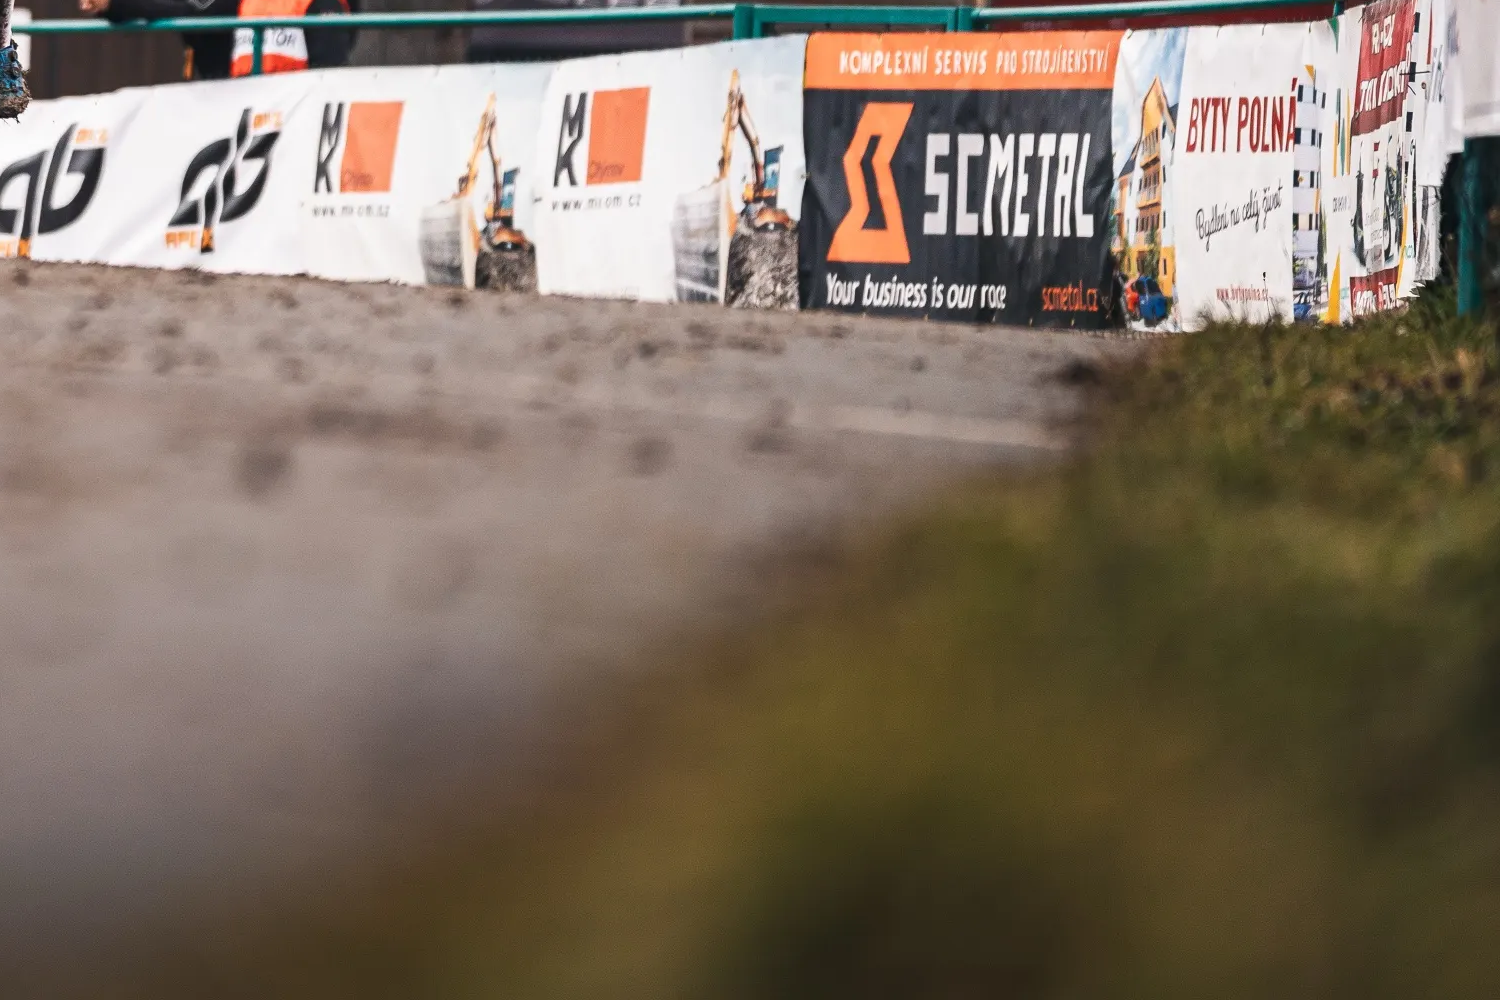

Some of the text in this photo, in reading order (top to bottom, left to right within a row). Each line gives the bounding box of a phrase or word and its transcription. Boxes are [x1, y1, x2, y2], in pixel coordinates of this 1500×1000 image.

[839, 41, 1110, 75] KOMPLEXNÍ SERVIS PRO STROJÍRENSTVÍ
[1186, 96, 1232, 153] BYTY
[1236, 77, 1298, 153] POLNÁ
[923, 133, 1094, 238] SCMETAL
[1196, 203, 1229, 252] Bydlení
[1231, 207, 1241, 227] na
[1262, 178, 1283, 230] život
[826, 272, 859, 306] Your
[862, 274, 928, 308] business
[931, 276, 945, 308] is
[947, 283, 976, 309] our
